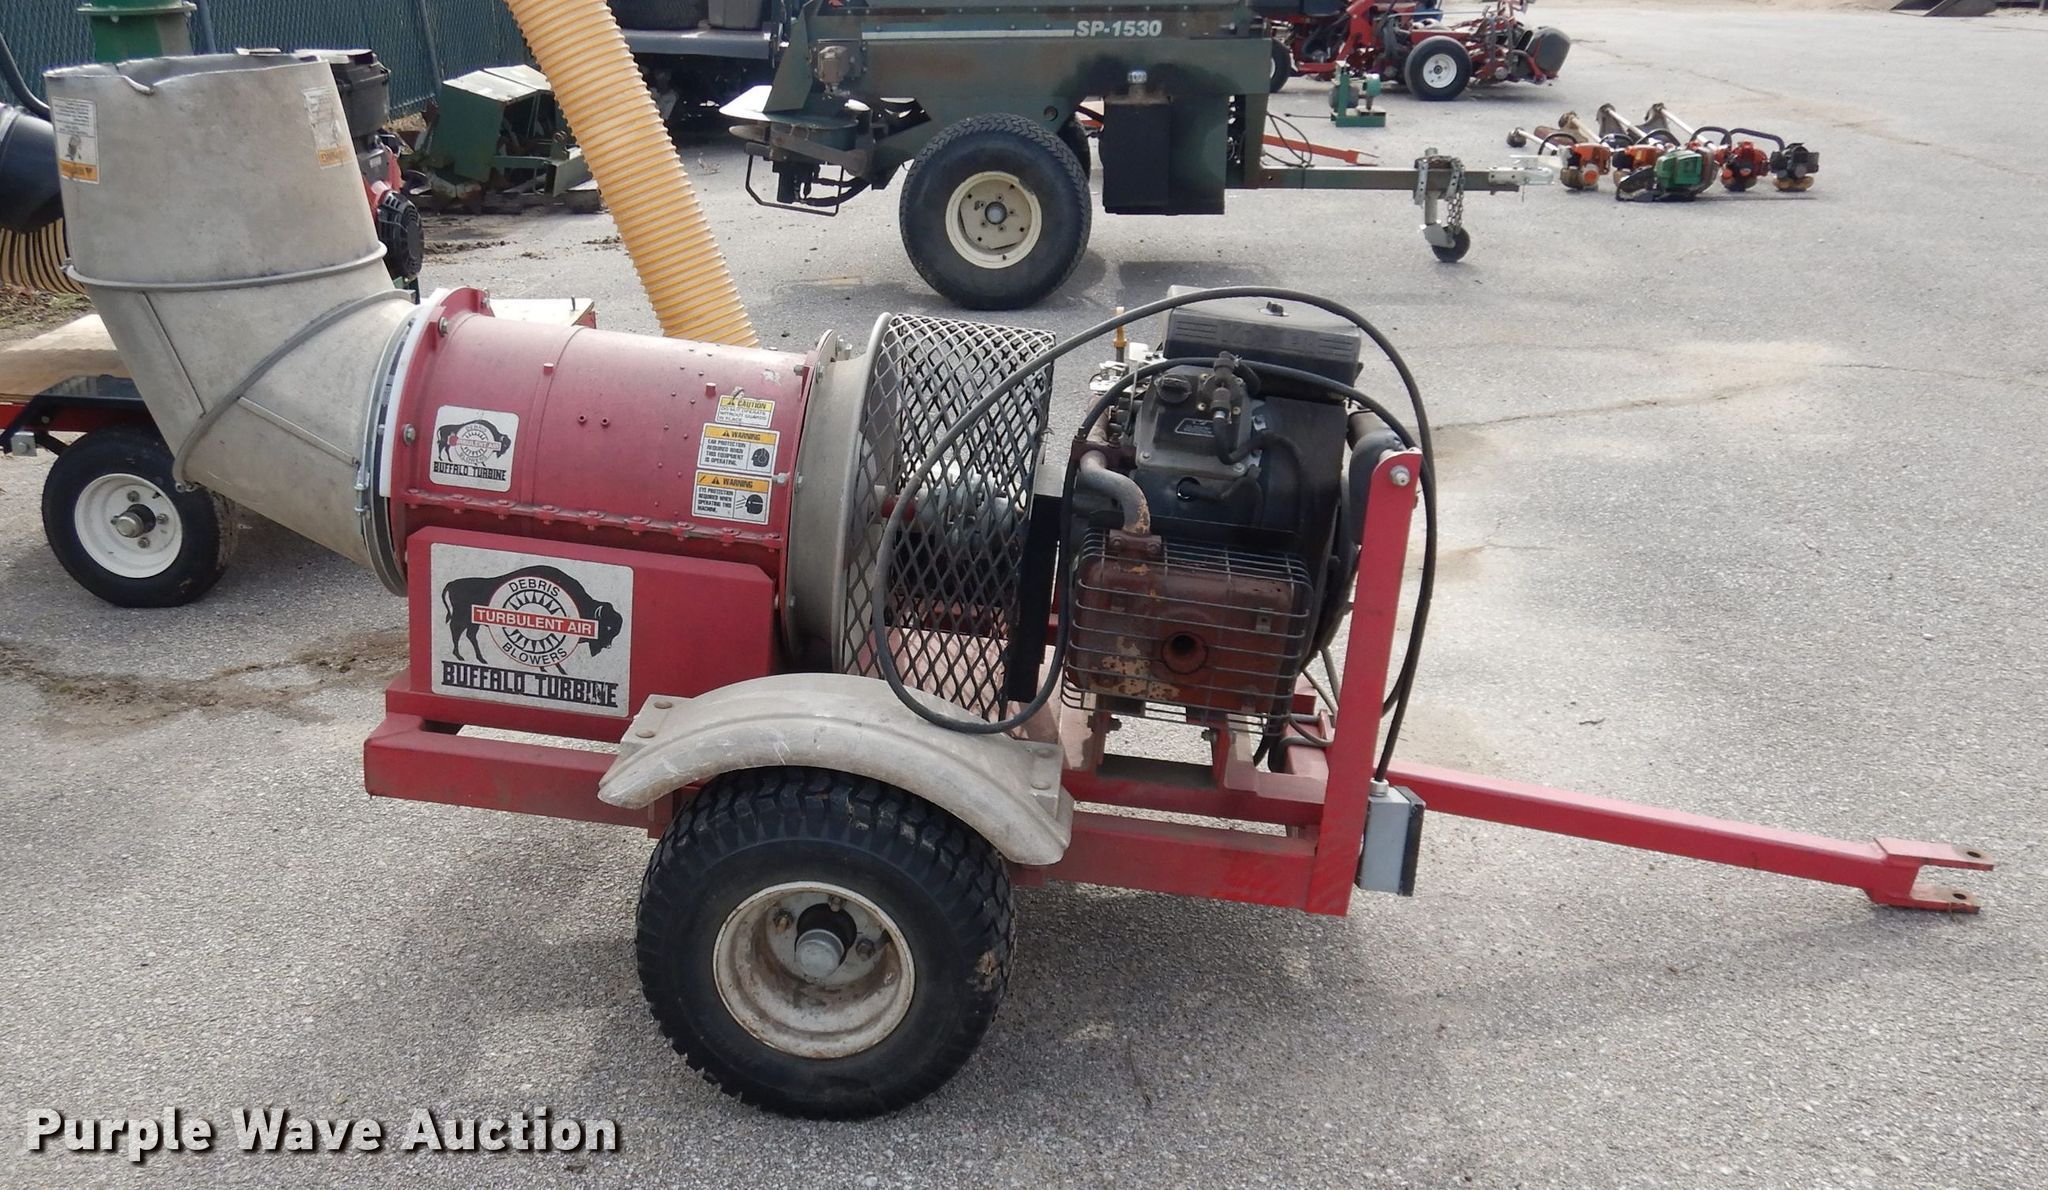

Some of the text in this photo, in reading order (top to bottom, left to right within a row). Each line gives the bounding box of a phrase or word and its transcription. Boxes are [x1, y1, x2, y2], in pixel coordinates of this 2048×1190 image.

[1076, 20, 1162, 37] SP-1530
[737, 400, 767, 410] CAUTION
[731, 431, 761, 441] WARNING
[718, 440, 746, 448] PROTECTION
[717, 452, 743, 460] EQUIPMENT
[433, 461, 507, 481] BUFFALO TURBINE
[722, 477, 753, 488] WARNING
[707, 488, 734, 496] PROTECTION
[698, 499, 721, 507] OPERATING
[508, 578, 561, 598] DEBRIS
[476, 608, 592, 635] TURBULENT AIR
[502, 642, 567, 665] BLOWERS
[442, 661, 618, 707] BUFFALO TURBINE
